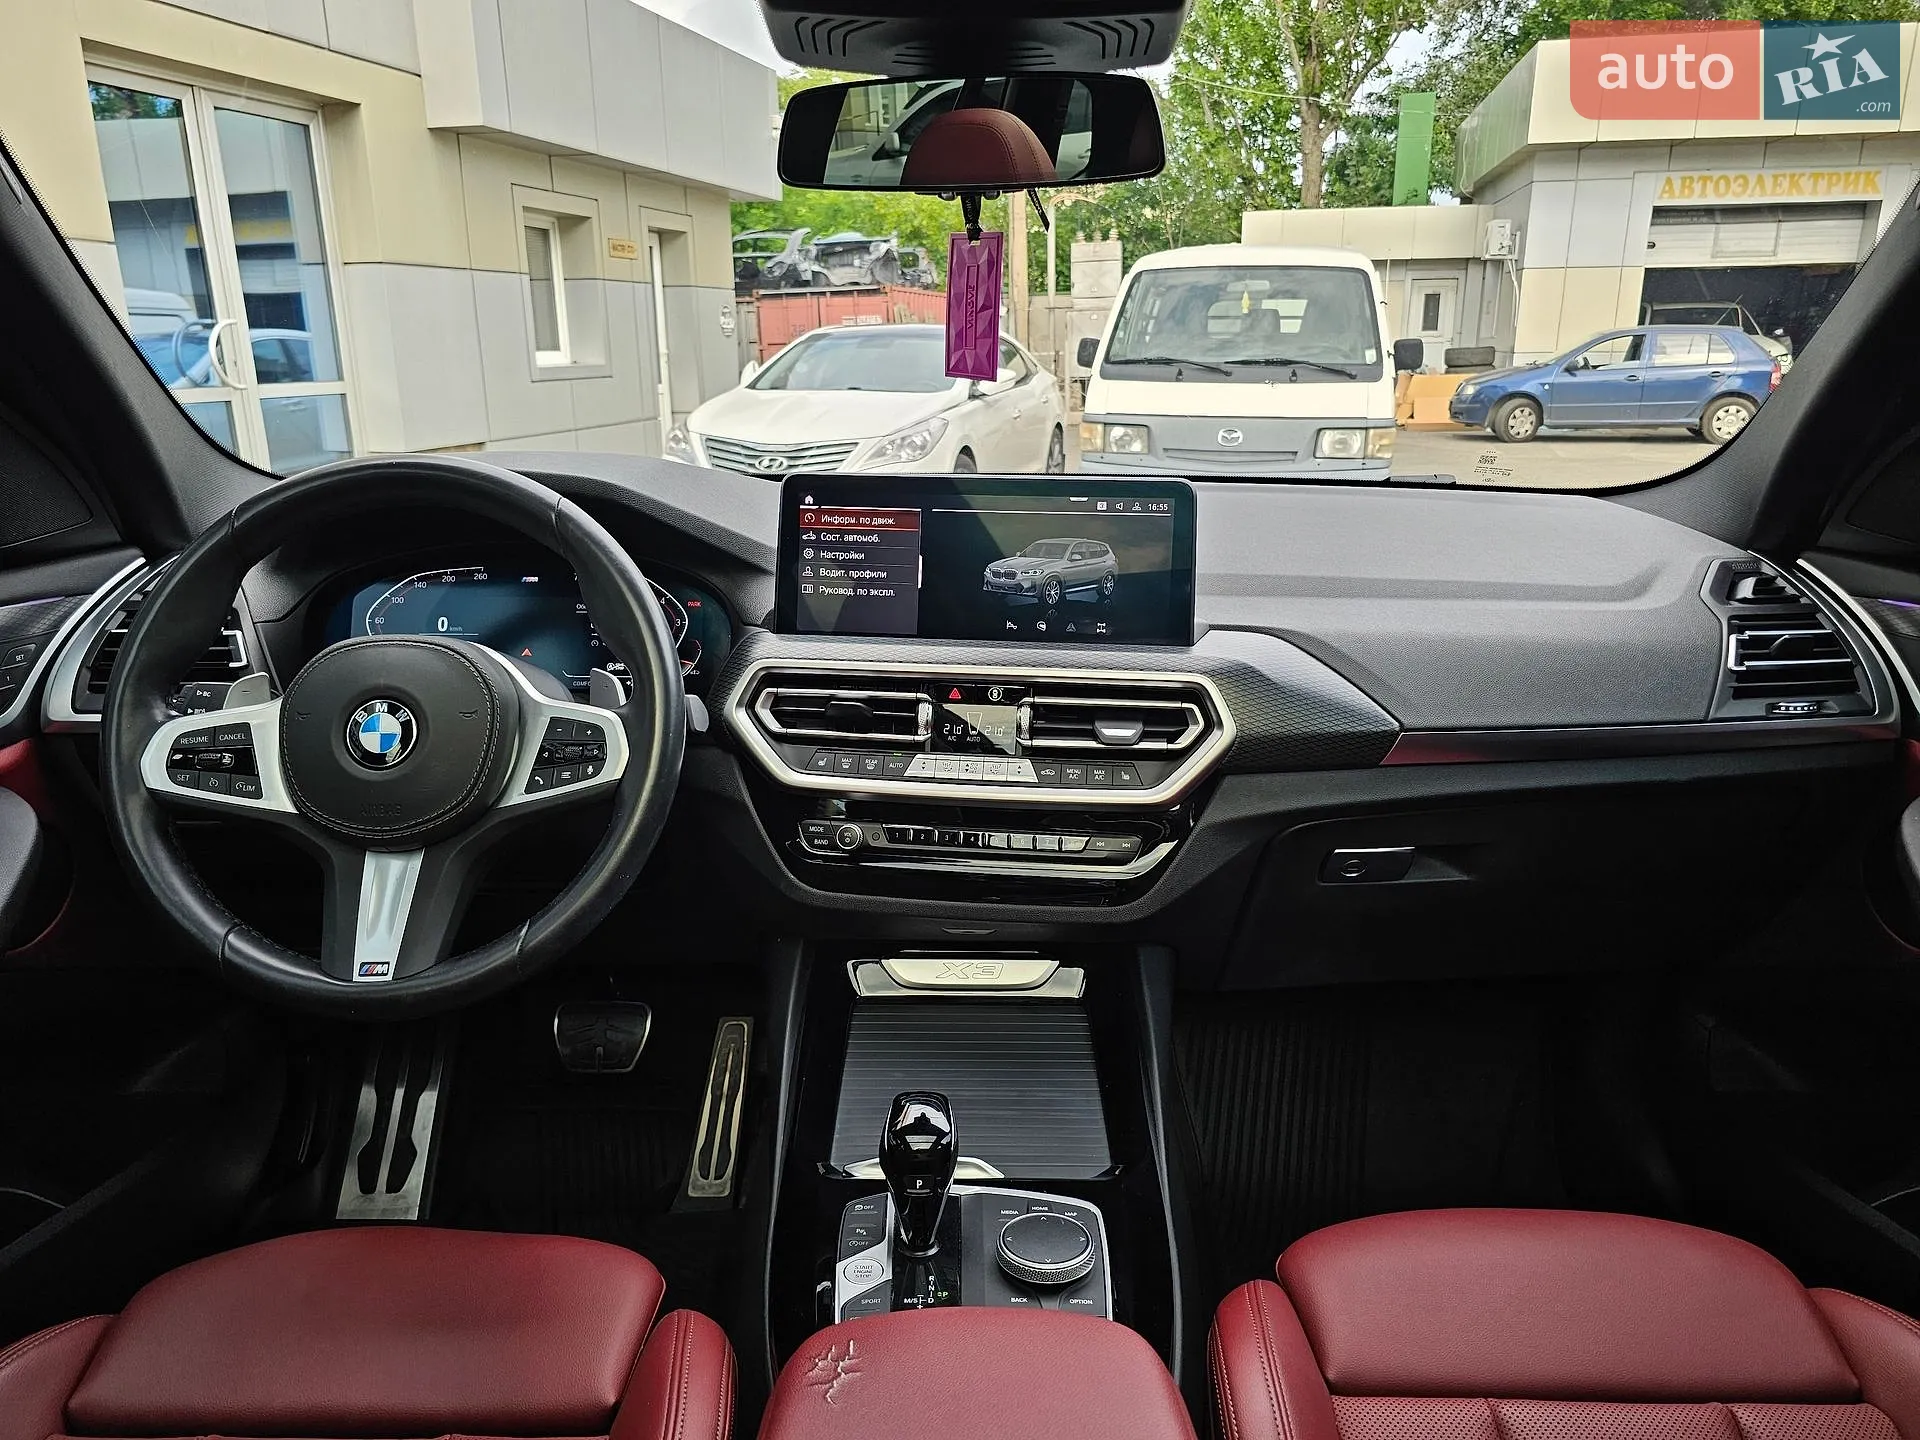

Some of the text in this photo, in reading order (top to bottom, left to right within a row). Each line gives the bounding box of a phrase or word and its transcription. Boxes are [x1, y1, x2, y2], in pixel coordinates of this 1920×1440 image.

[1658, 171, 1882, 199] АВТОЭЛЕКТРИК
[1148, 503, 1169, 511] 16:55
[821, 514, 858, 526] Информ.
[872, 517, 896, 526] движ.
[821, 532, 881, 543] Сост. автомоб.
[820, 550, 865, 561] Настройки
[473, 573, 488, 581] 260
[820, 567, 887, 580] Водит. профили
[441, 575, 456, 583] 200
[414, 581, 427, 589] 140
[819, 585, 896, 597] Руковод. по экспл.
[391, 596, 405, 604] 100
[660, 597, 666, 605] 4
[374, 616, 385, 625] 60
[437, 616, 449, 632] 0
[675, 618, 681, 627] 3
[355, 702, 410, 724] BMW
[180, 735, 209, 745] RESUME
[219, 732, 246, 741] CANCEL
[242, 784, 256, 792] LIM
[809, 825, 825, 833] MODE
[936, 962, 1004, 980] X3
[916, 1179, 923, 1189] P
